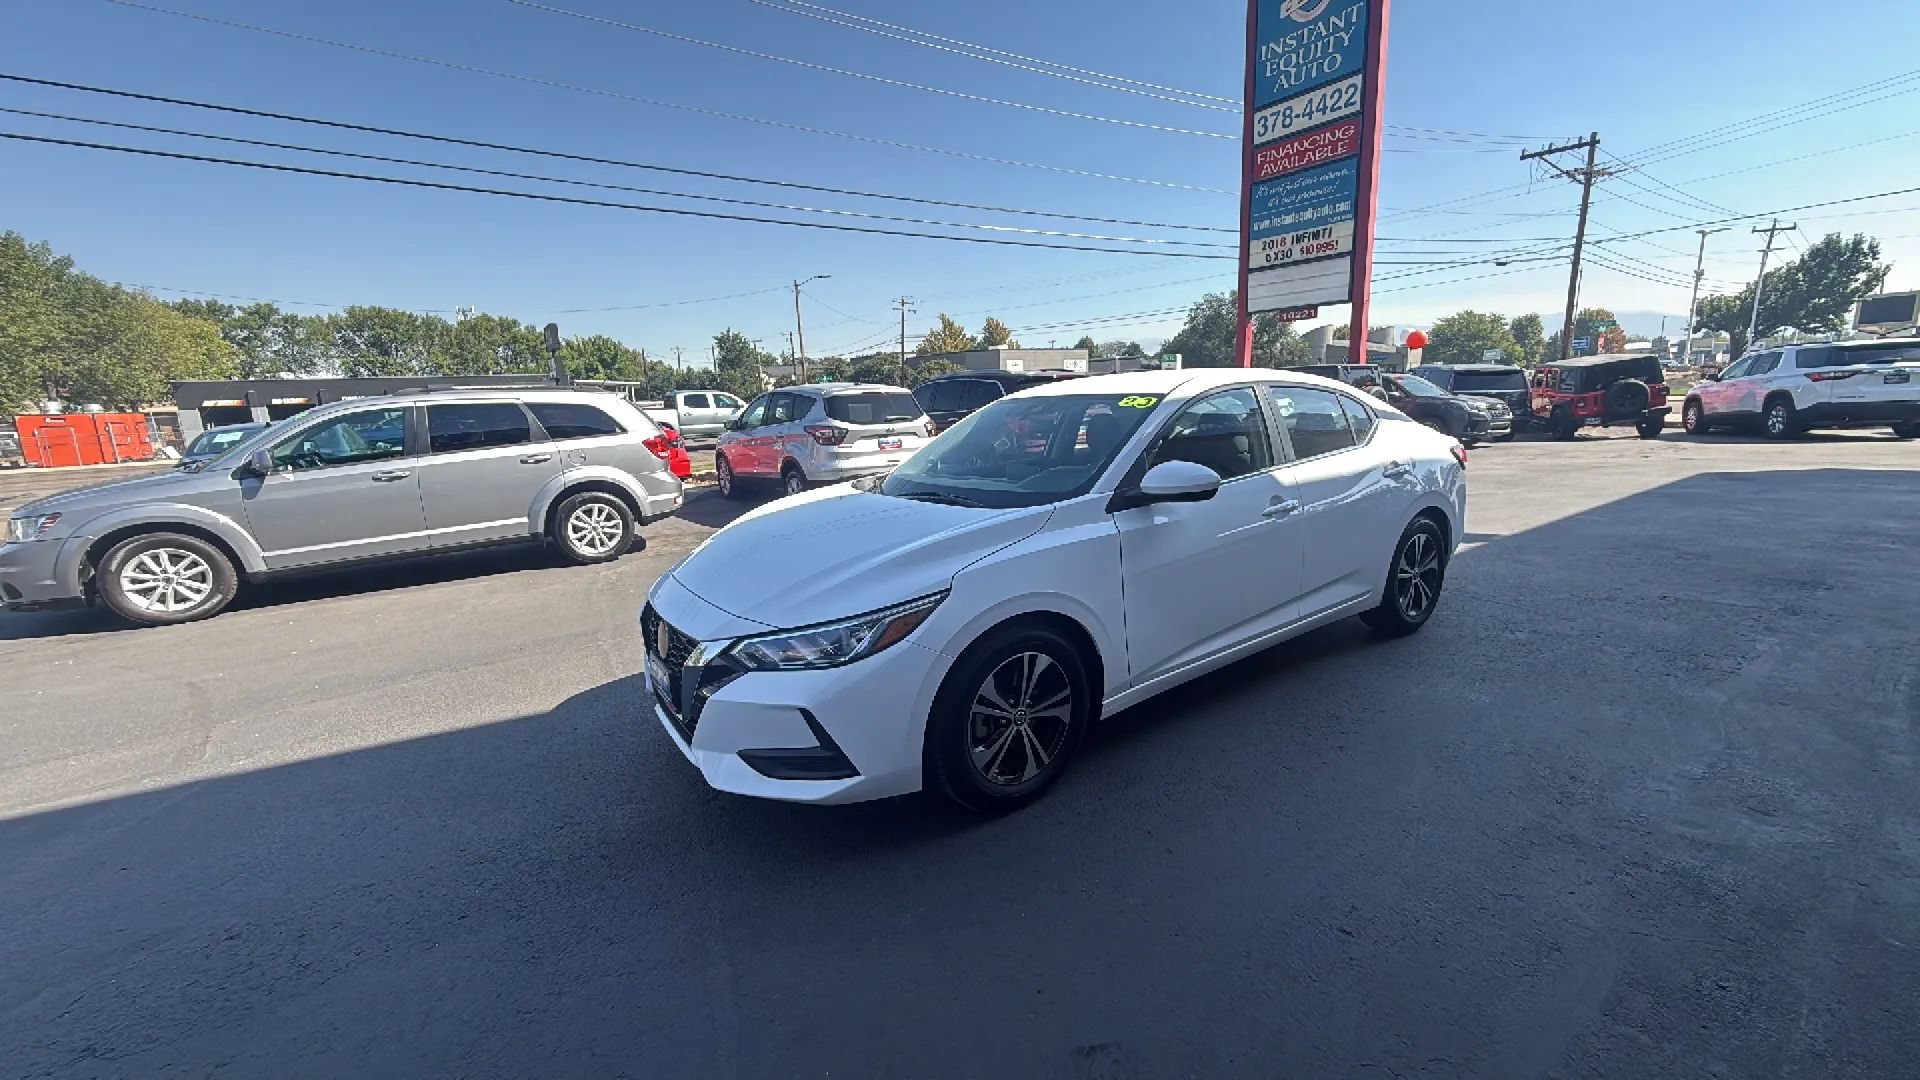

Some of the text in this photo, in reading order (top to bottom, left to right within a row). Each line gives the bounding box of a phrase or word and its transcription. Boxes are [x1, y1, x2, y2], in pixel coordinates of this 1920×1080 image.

[1261, 2, 1363, 61] INSTANT
[1265, 26, 1355, 77] EQUITY
[1273, 53, 1342, 93] AUTO
[1257, 83, 1358, 137] 378-4422
[1257, 125, 1355, 165] FINANCING
[1260, 140, 1349, 176] AVAILABLE
[1253, 200, 1351, 231] www.instantequityauto.com
[1262, 227, 1333, 251] 2018 INFINITI
[1281, 309, 1315, 321] 10221
